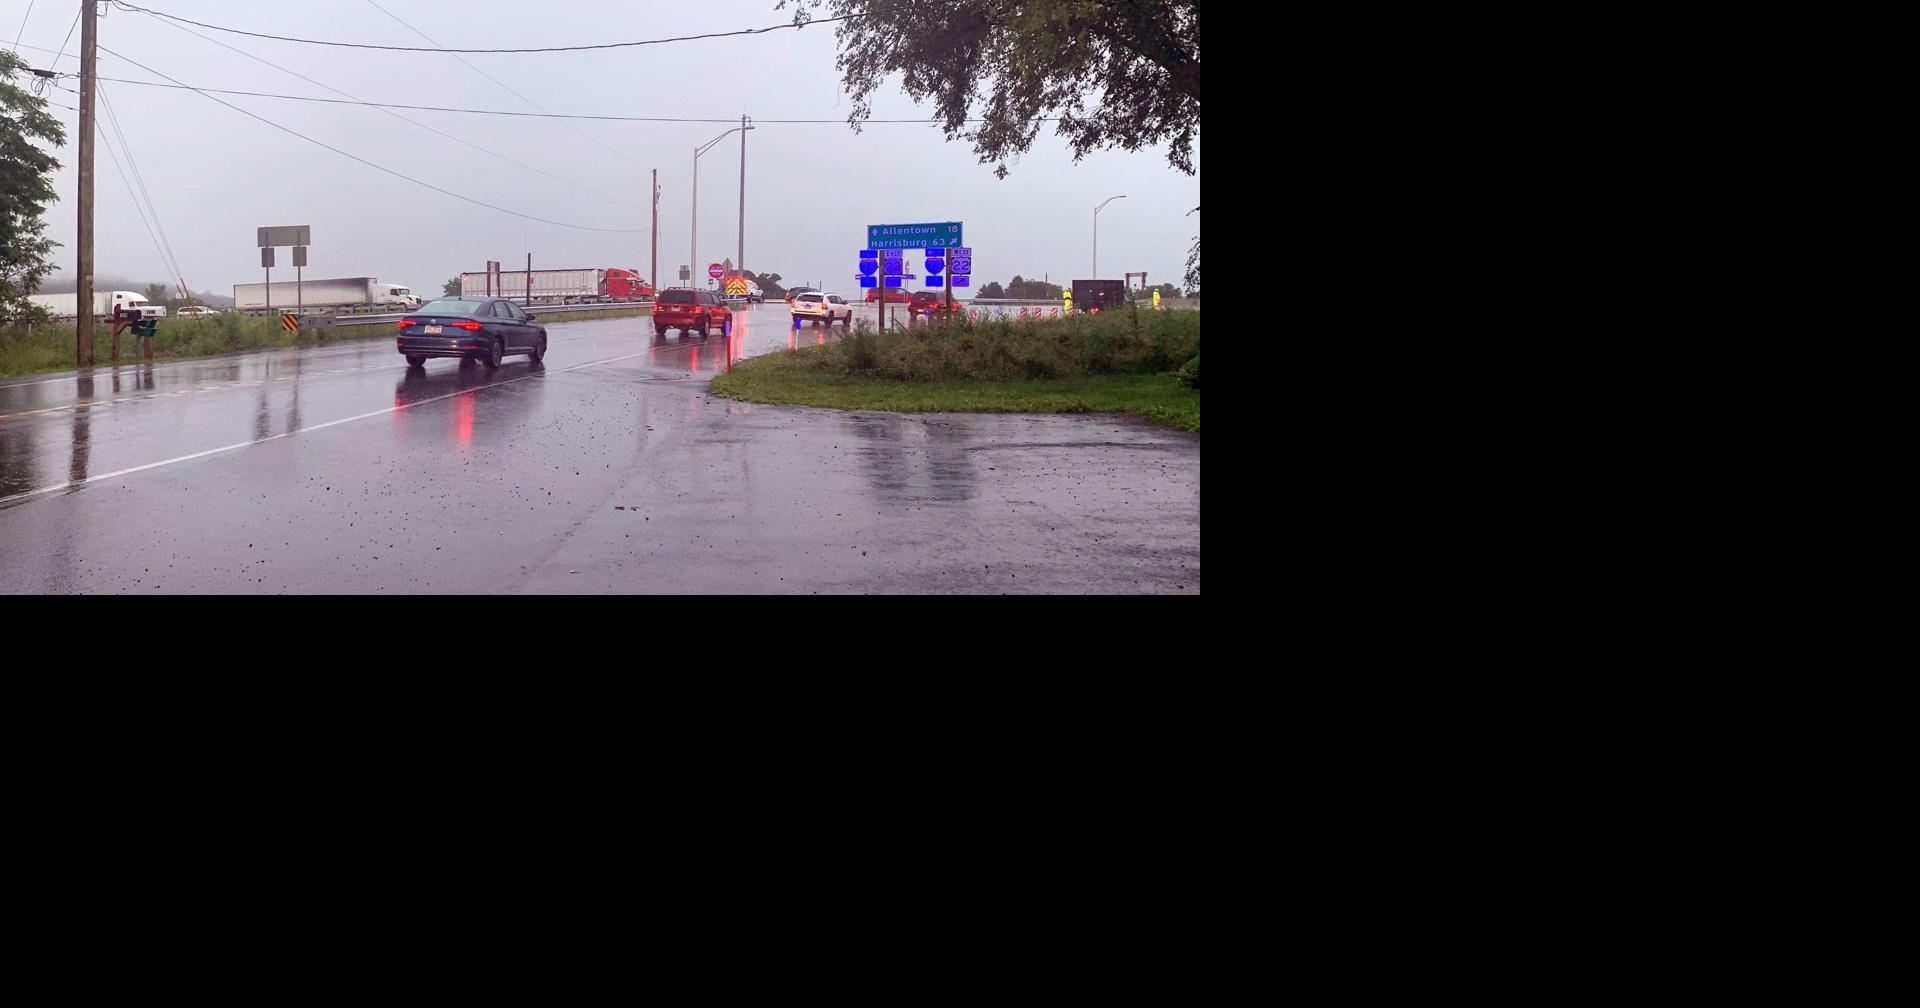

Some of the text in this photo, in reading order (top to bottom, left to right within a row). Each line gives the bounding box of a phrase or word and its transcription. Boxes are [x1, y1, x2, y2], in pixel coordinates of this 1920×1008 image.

[883, 227, 936, 235] Allentown
[871, 239, 927, 248] Harrisburg
[953, 261, 969, 271] 22
